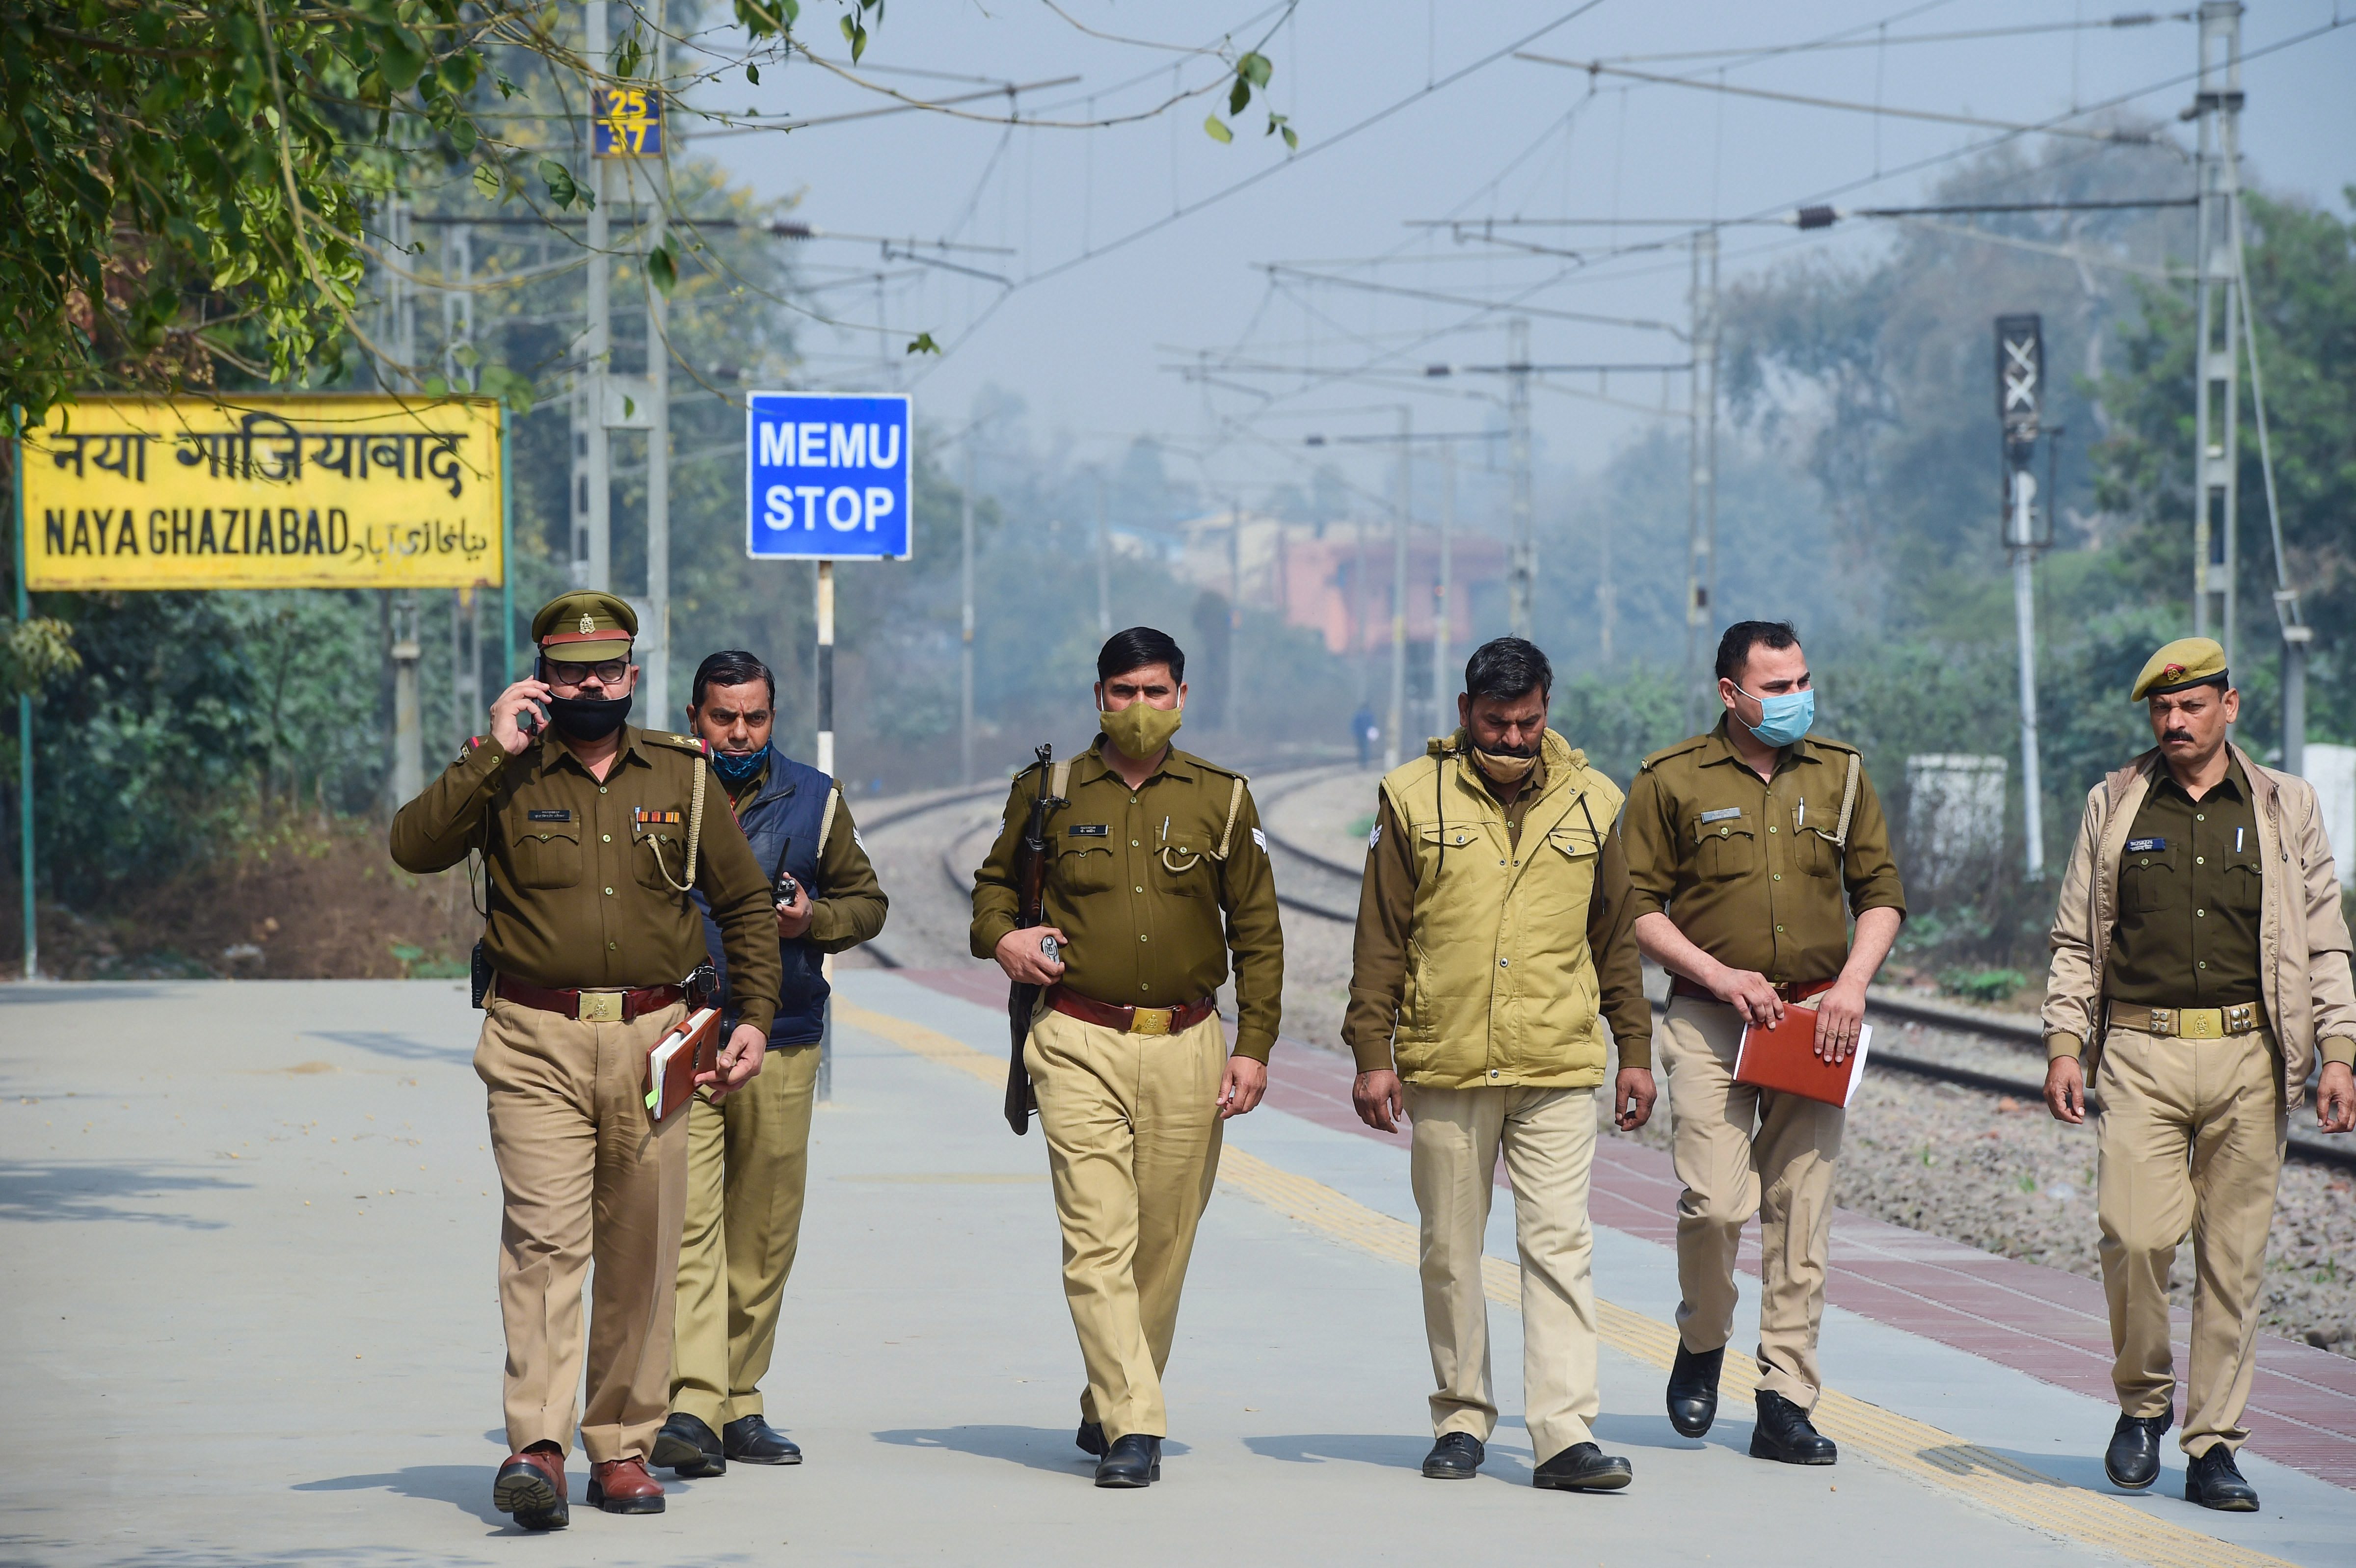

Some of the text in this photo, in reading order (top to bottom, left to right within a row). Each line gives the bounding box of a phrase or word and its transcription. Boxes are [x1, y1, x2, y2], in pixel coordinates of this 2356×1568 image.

[608, 88, 647, 119] 25
[608, 124, 647, 154] 37
[50, 412, 468, 498] नया गाज़ियाबाद
[759, 421, 901, 470] MEMU
[45, 508, 348, 556] NAYA GHAZIABAD
[763, 484, 895, 532] STOP
